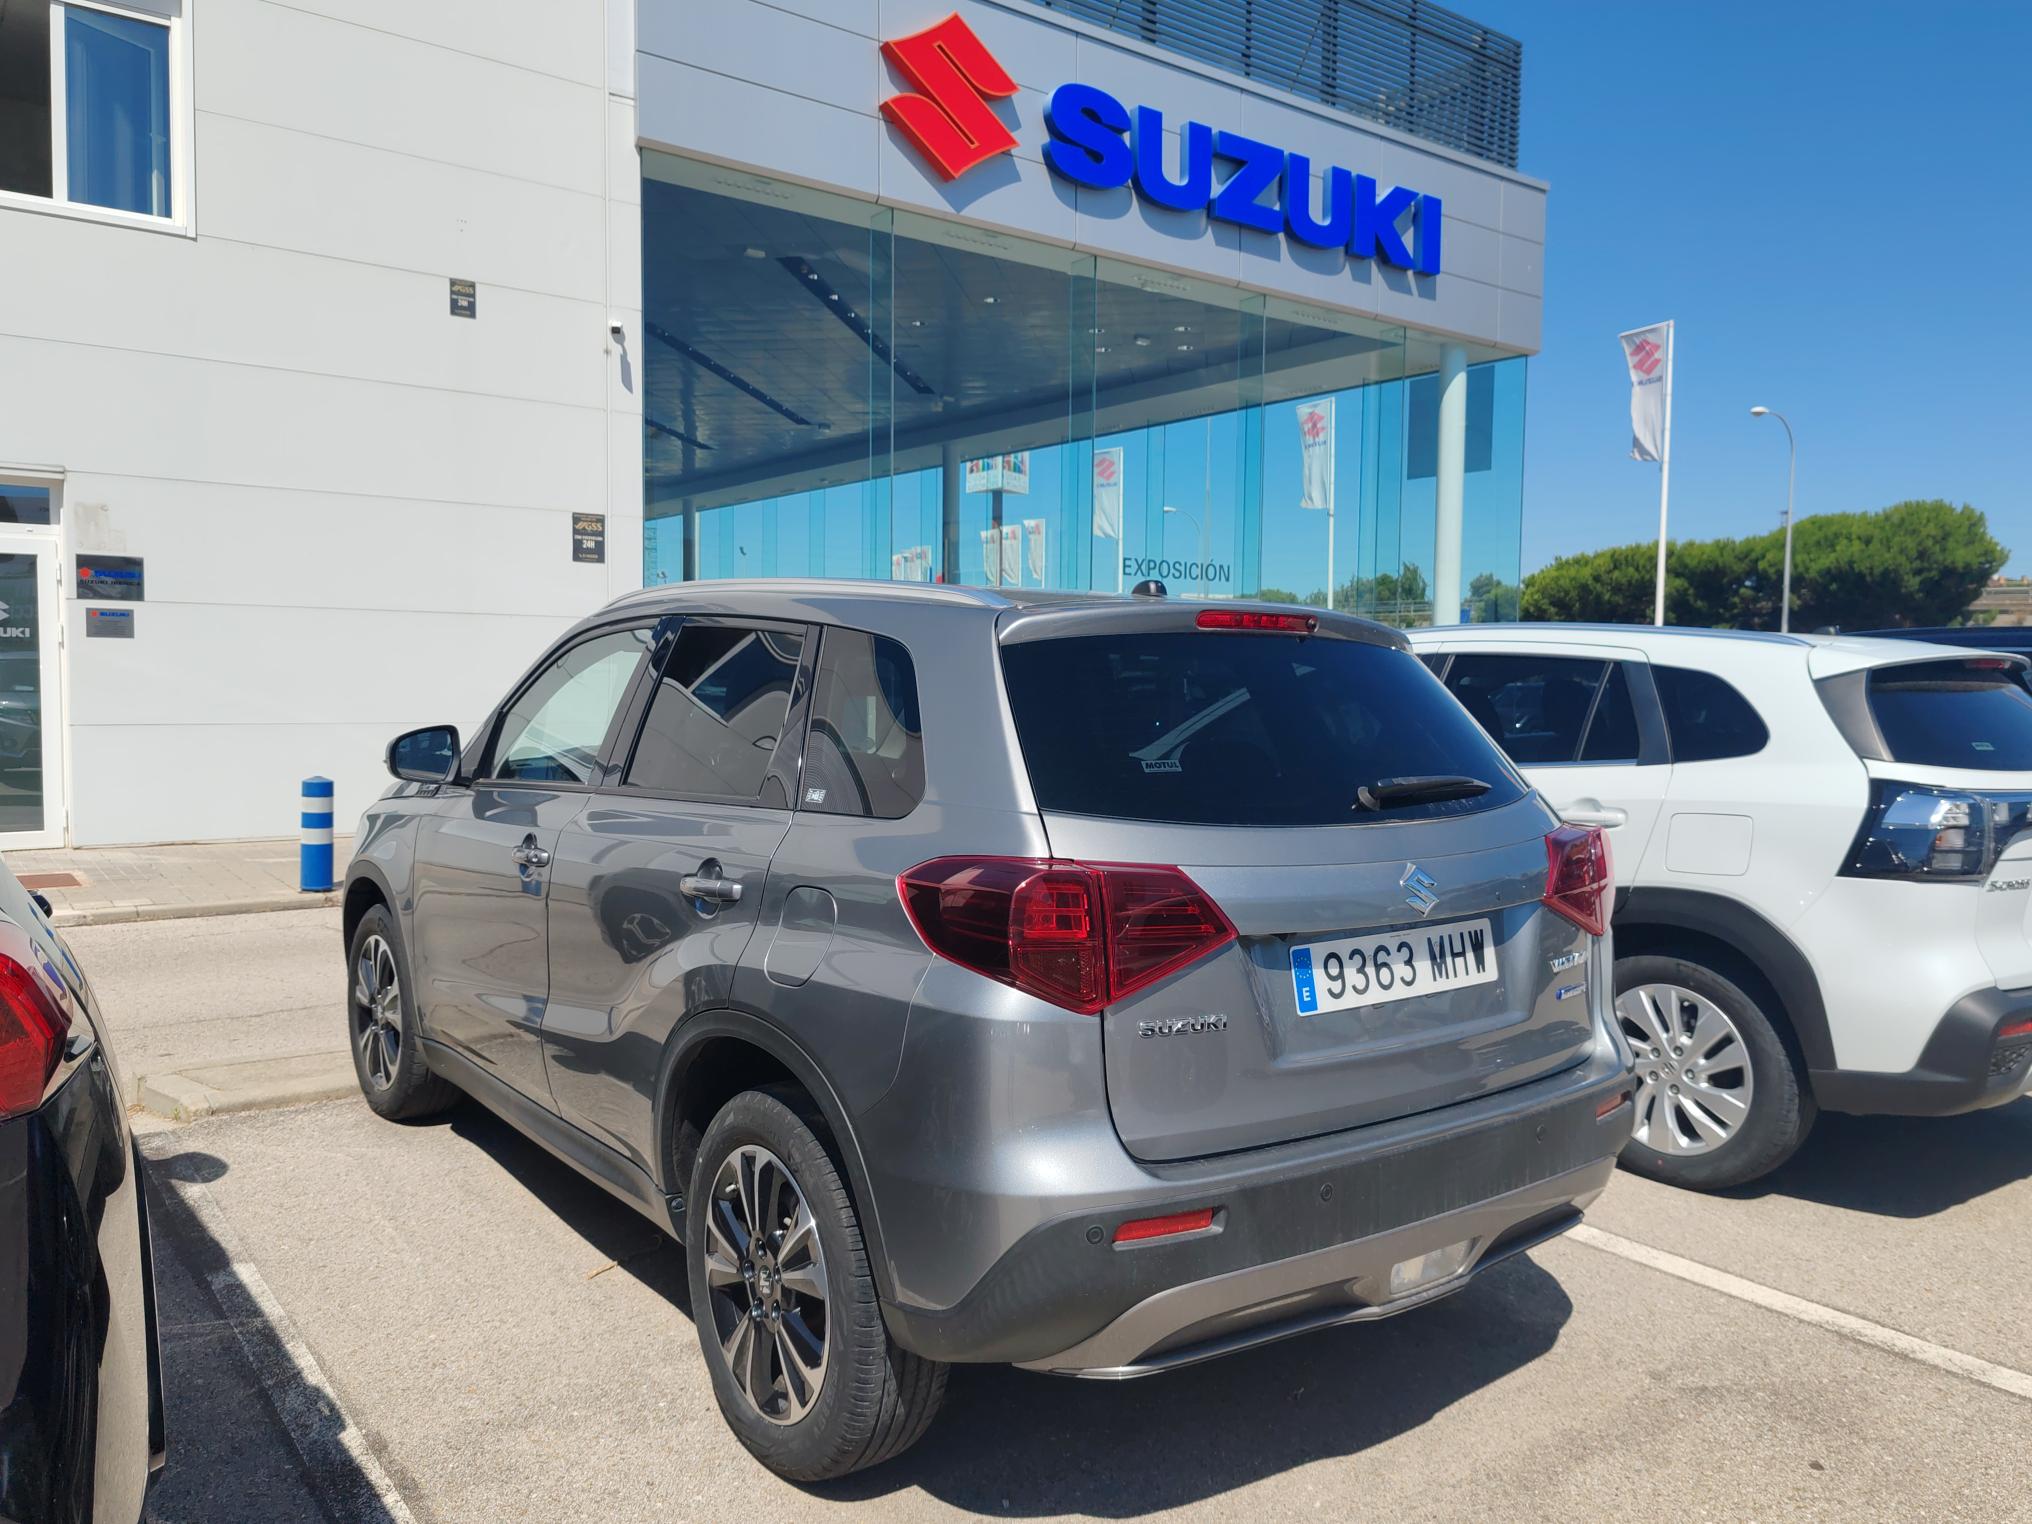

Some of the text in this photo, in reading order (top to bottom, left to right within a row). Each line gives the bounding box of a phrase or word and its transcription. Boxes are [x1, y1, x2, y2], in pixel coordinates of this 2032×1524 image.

[1042, 83, 1442, 275] SUZUKI
[1123, 557, 1230, 583] EXPOSICIÓN
[1145, 761, 1179, 769] MOTUL
[1323, 941, 1417, 1000] 9363
[1427, 928, 1487, 982] MHW
[1302, 986, 1312, 1002] E
[1138, 1013, 1228, 1038] SUZUKI
